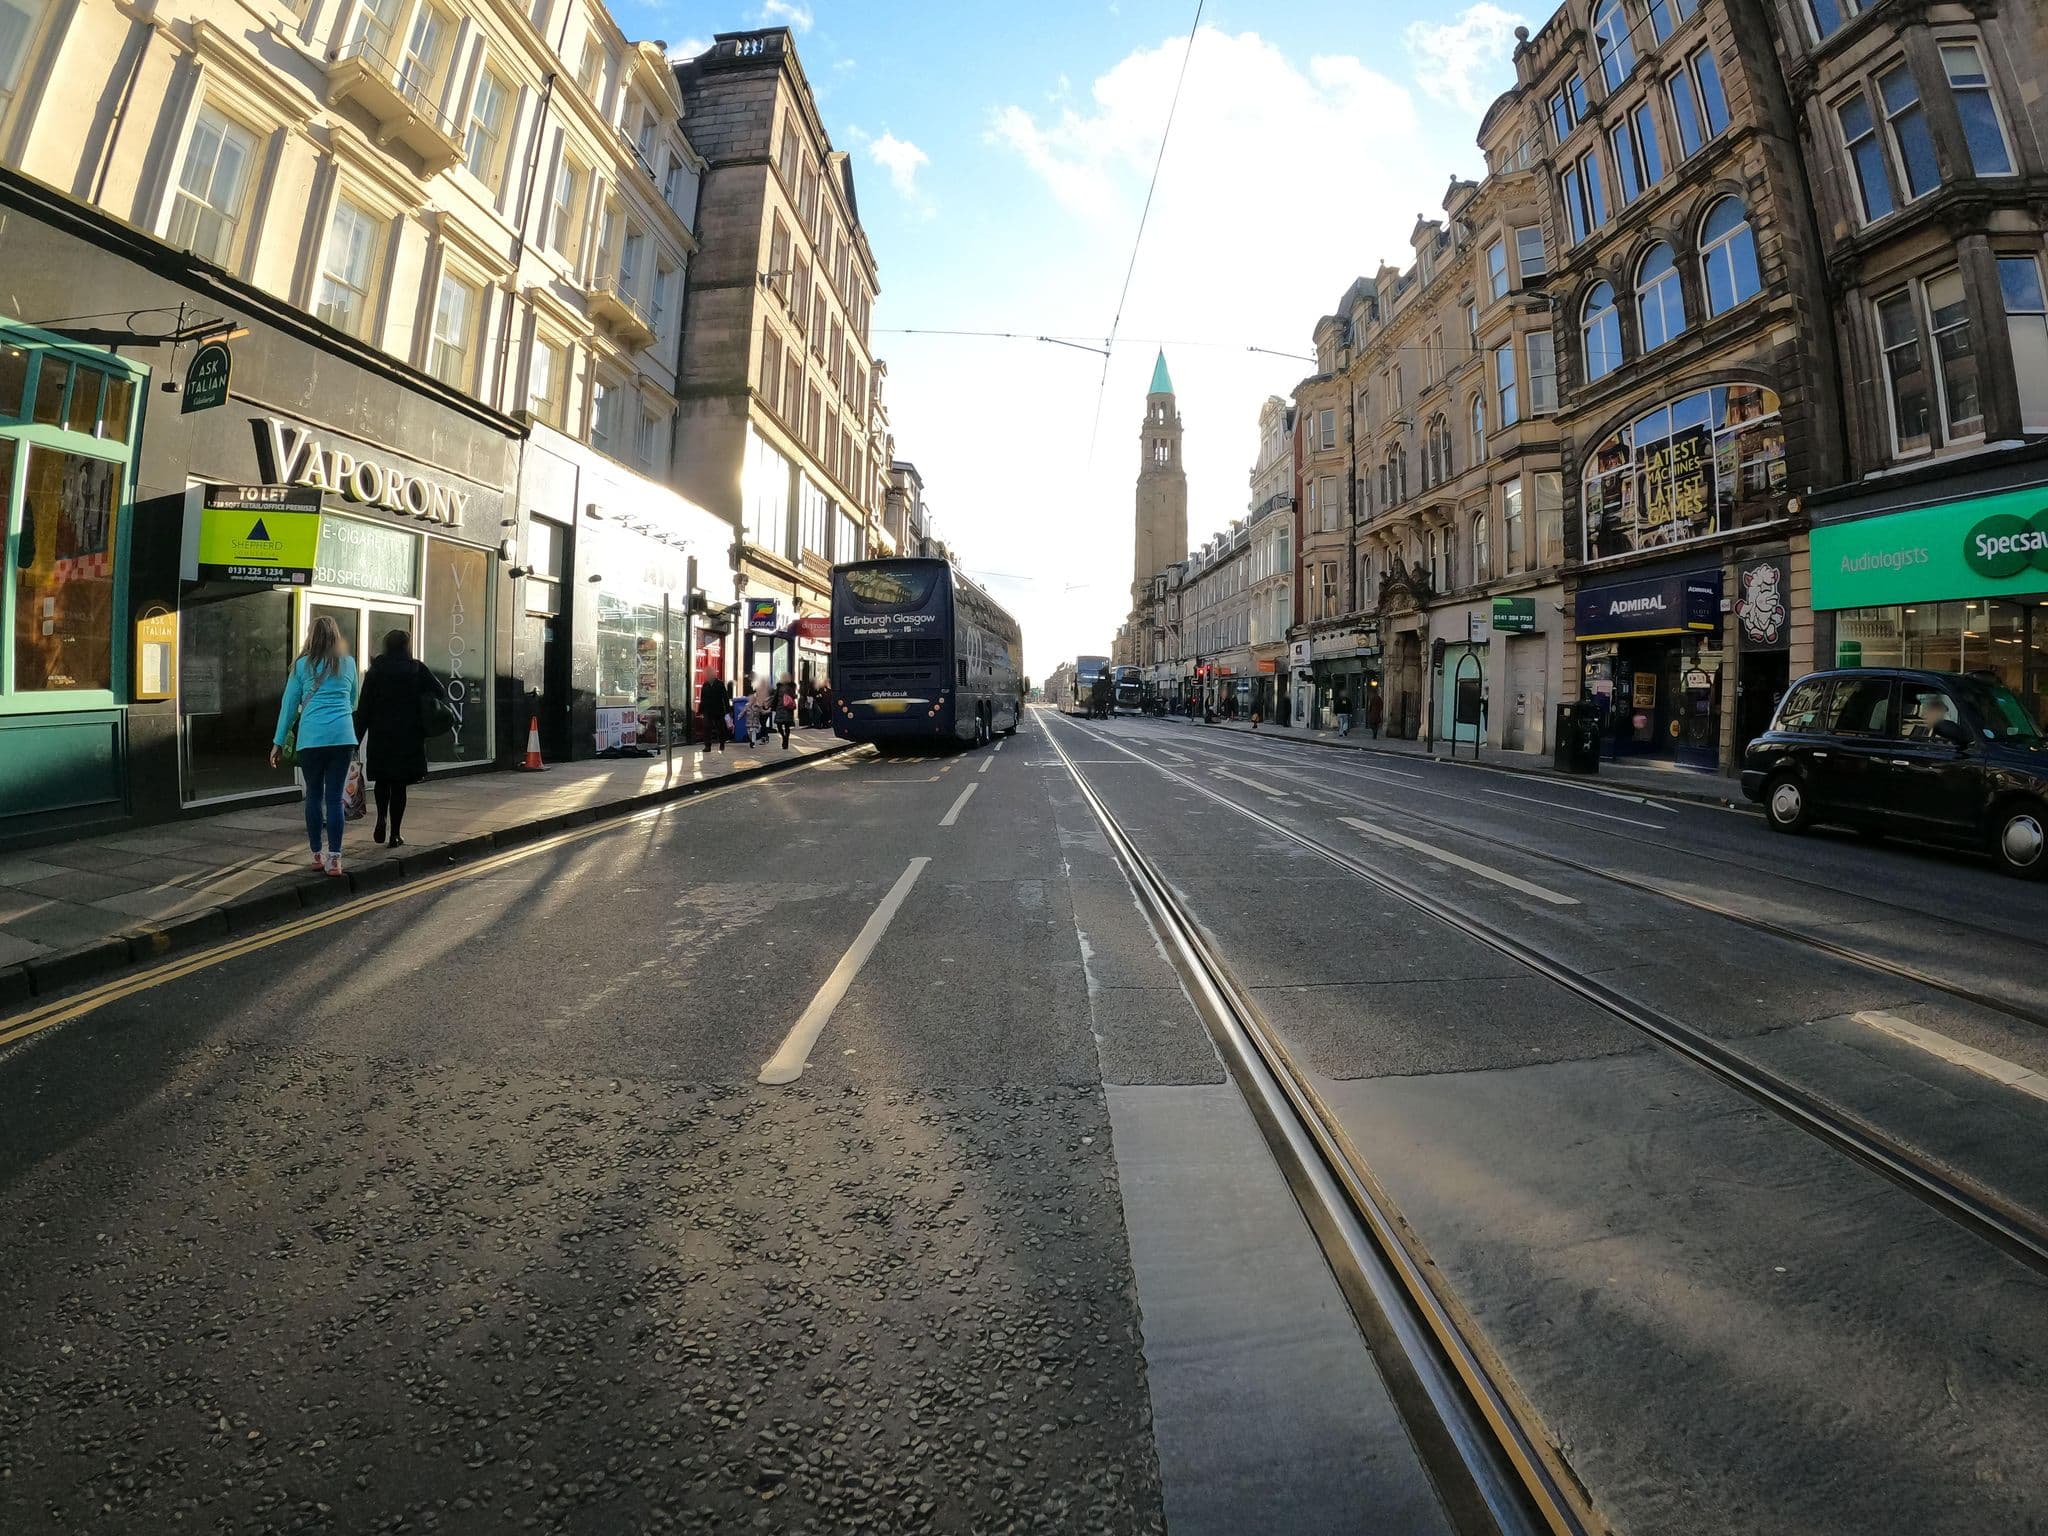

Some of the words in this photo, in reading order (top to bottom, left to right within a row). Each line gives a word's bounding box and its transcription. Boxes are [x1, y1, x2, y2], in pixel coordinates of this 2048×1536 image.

[199, 360, 218, 377] ASK
[187, 374, 226, 396] ITALIAN
[1644, 437, 1699, 472] LATEST
[249, 416, 471, 527] VAPORONY
[1647, 456, 1701, 484] MACHINES
[238, 487, 259, 501] TO
[261, 488, 288, 502] LET
[1648, 475, 1701, 507] LATEST
[1648, 495, 1704, 526] GAMES
[231, 539, 283, 551] SHEPHERD
[228, 566, 246, 574] 0131
[247, 567, 262, 575] 225
[265, 568, 284, 576] 1234
[1841, 547, 1929, 573] Audiologists
[336, 569, 409, 594] SPECIALISTS
[1688, 586, 1714, 594] ADMIRAL
[1609, 594, 1667, 616] ADMIRAL
[143, 626, 172, 636] ITALIAN
[150, 617, 166, 625] ASK
[843, 614, 892, 627] Edinburgh
[893, 613, 936, 626] Glasgow
[448, 562, 470, 745] VAPORONY
[871, 690, 908, 699] citylink.co.uk
